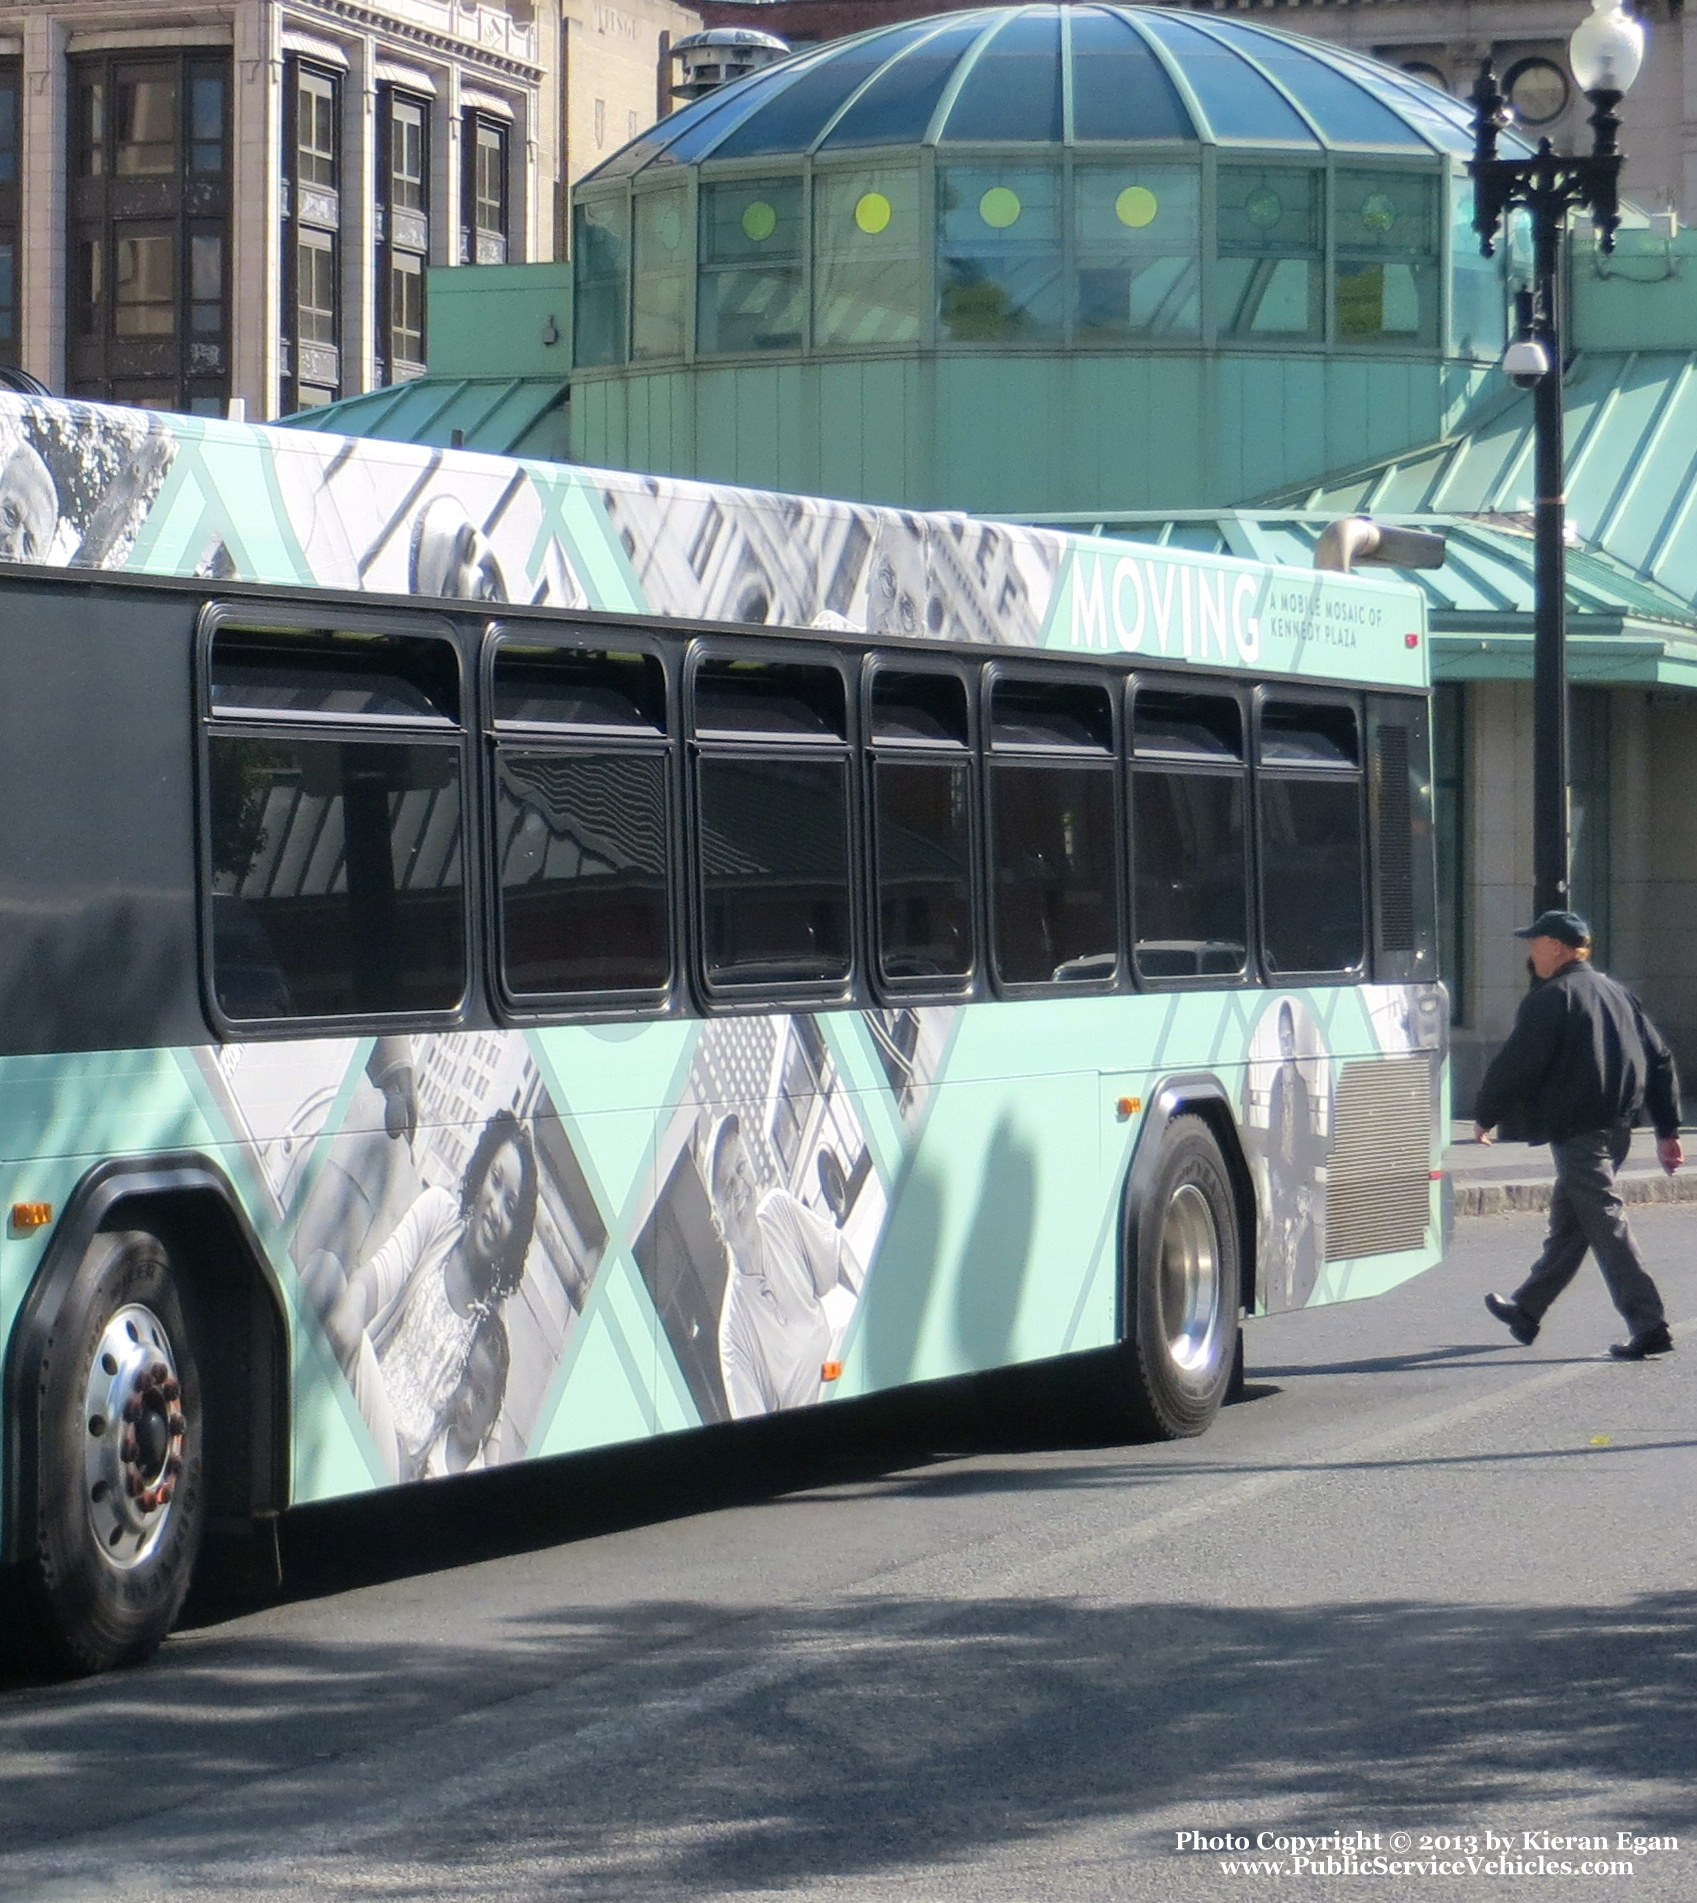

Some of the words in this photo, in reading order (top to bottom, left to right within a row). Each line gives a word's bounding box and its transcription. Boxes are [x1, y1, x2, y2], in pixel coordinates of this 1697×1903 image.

[1071, 552, 1261, 663] MOVING
[1269, 592, 1278, 610] A
[1280, 592, 1322, 618] MOBILE
[1325, 600, 1366, 625] MOSAIC
[1368, 608, 1382, 627] OF
[1270, 616, 1323, 641] KENNEDY
[1325, 624, 1357, 648] PLAZA
